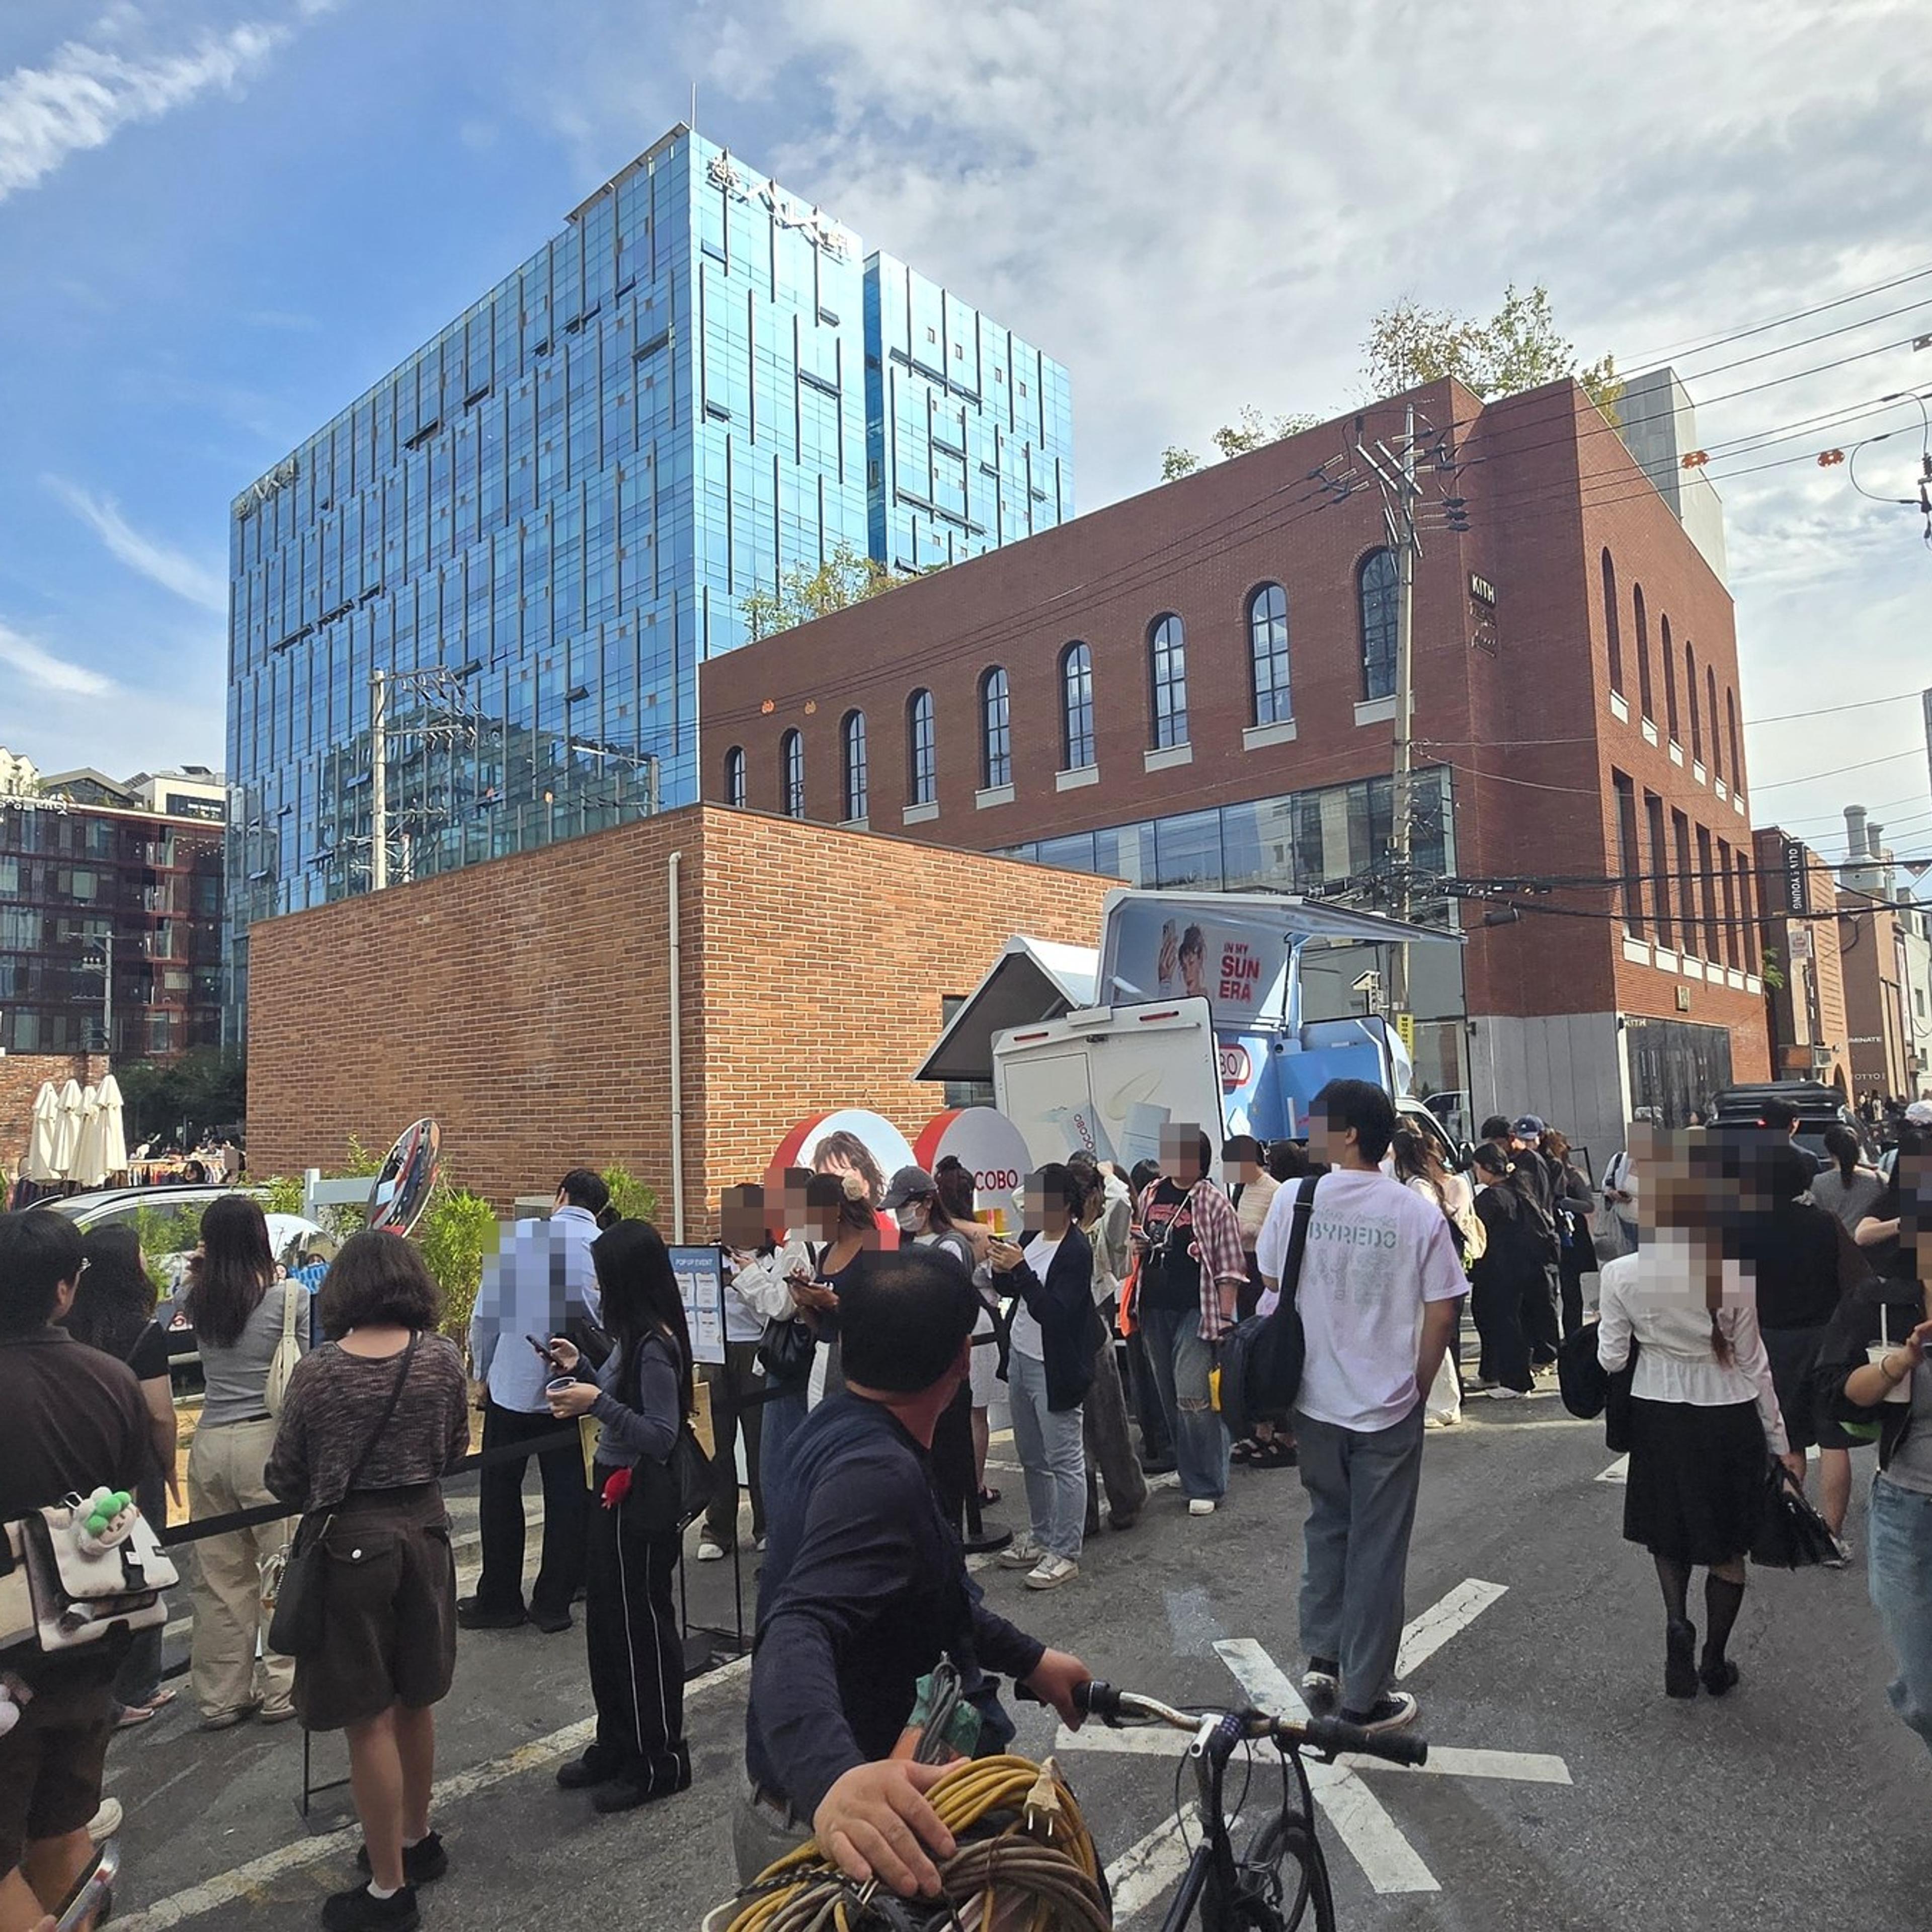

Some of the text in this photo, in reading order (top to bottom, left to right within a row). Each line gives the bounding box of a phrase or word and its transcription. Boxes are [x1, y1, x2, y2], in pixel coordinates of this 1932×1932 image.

[1472, 574, 1495, 603] KITH
[1791, 878, 1803, 910] YOUNG
[1221, 955, 1260, 979] SUN
[1220, 980, 1251, 1002] ERA
[975, 1169, 1018, 1191] COBO
[1309, 1221, 1397, 1249] BYREDO
